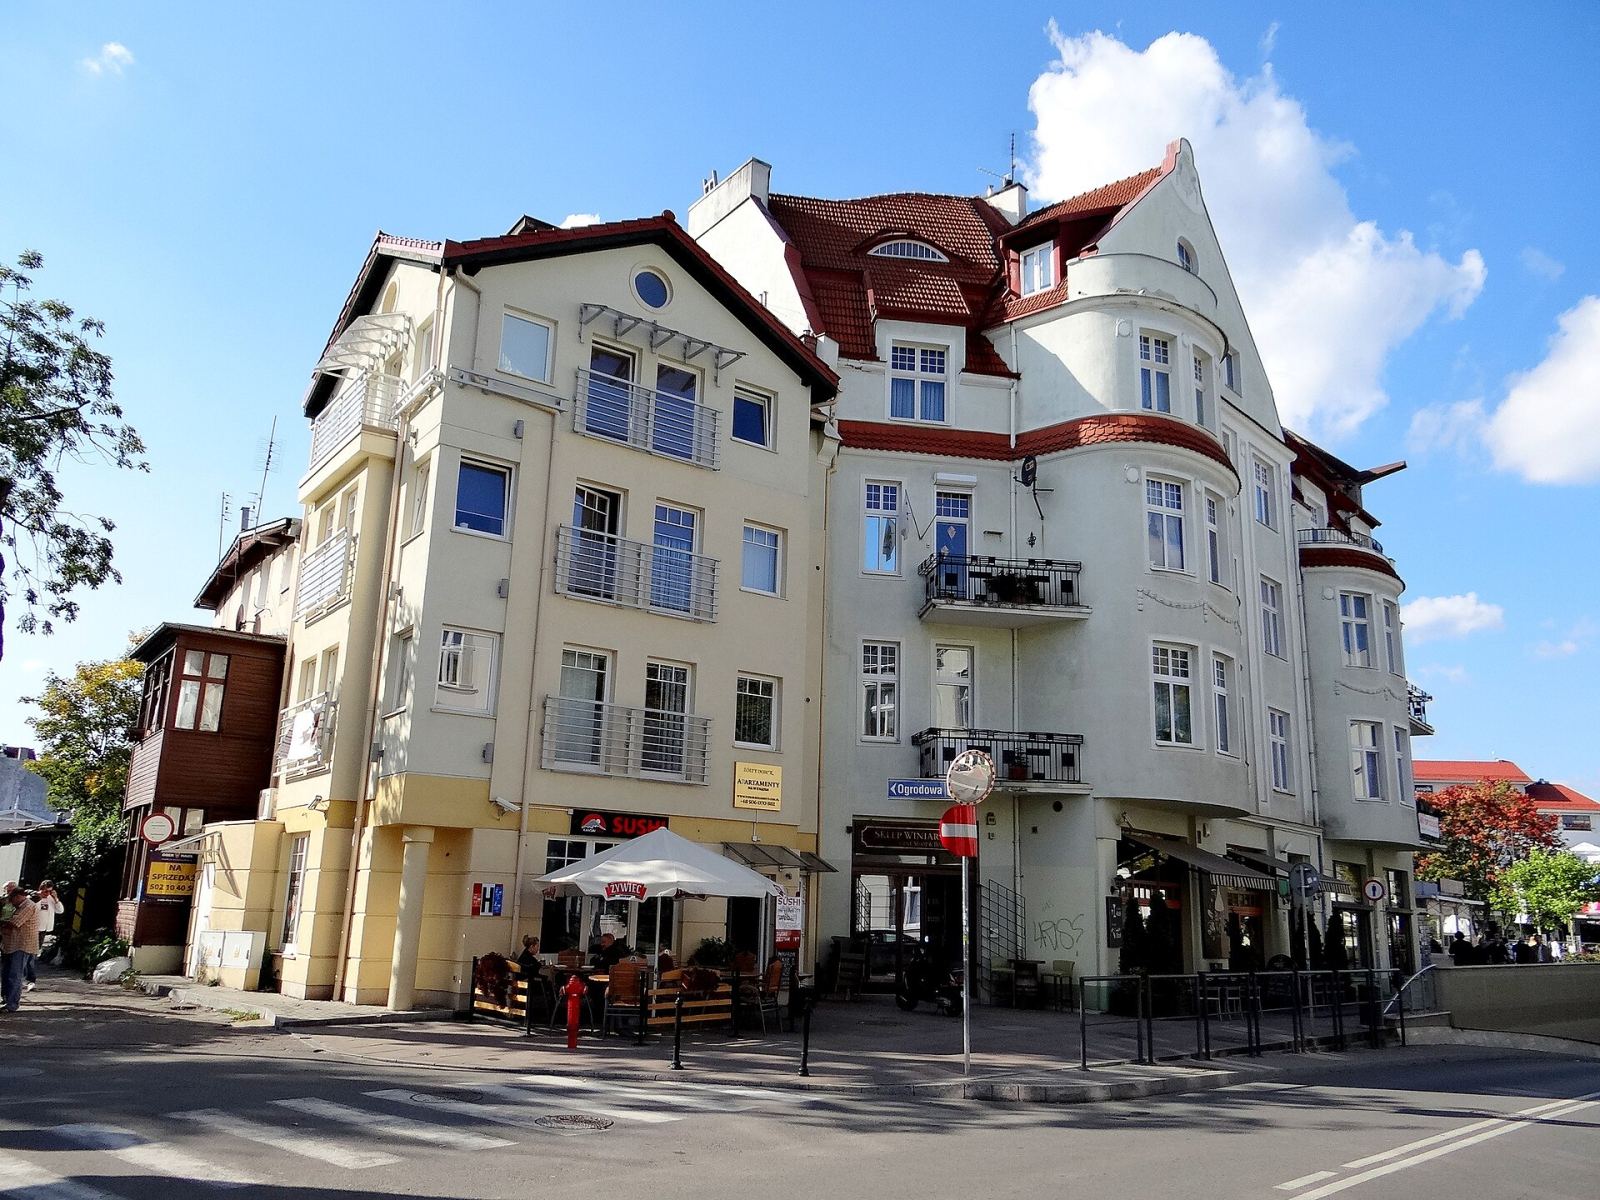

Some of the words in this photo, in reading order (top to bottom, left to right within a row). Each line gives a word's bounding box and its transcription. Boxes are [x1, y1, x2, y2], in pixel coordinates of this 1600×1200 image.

[897, 783, 943, 797] Ogrodowa
[874, 830, 903, 840] SKLEP
[903, 832, 941, 841] WINIAR
[609, 881, 642, 894] ŻYWIEC
[778, 898, 800, 906] SUSHI
